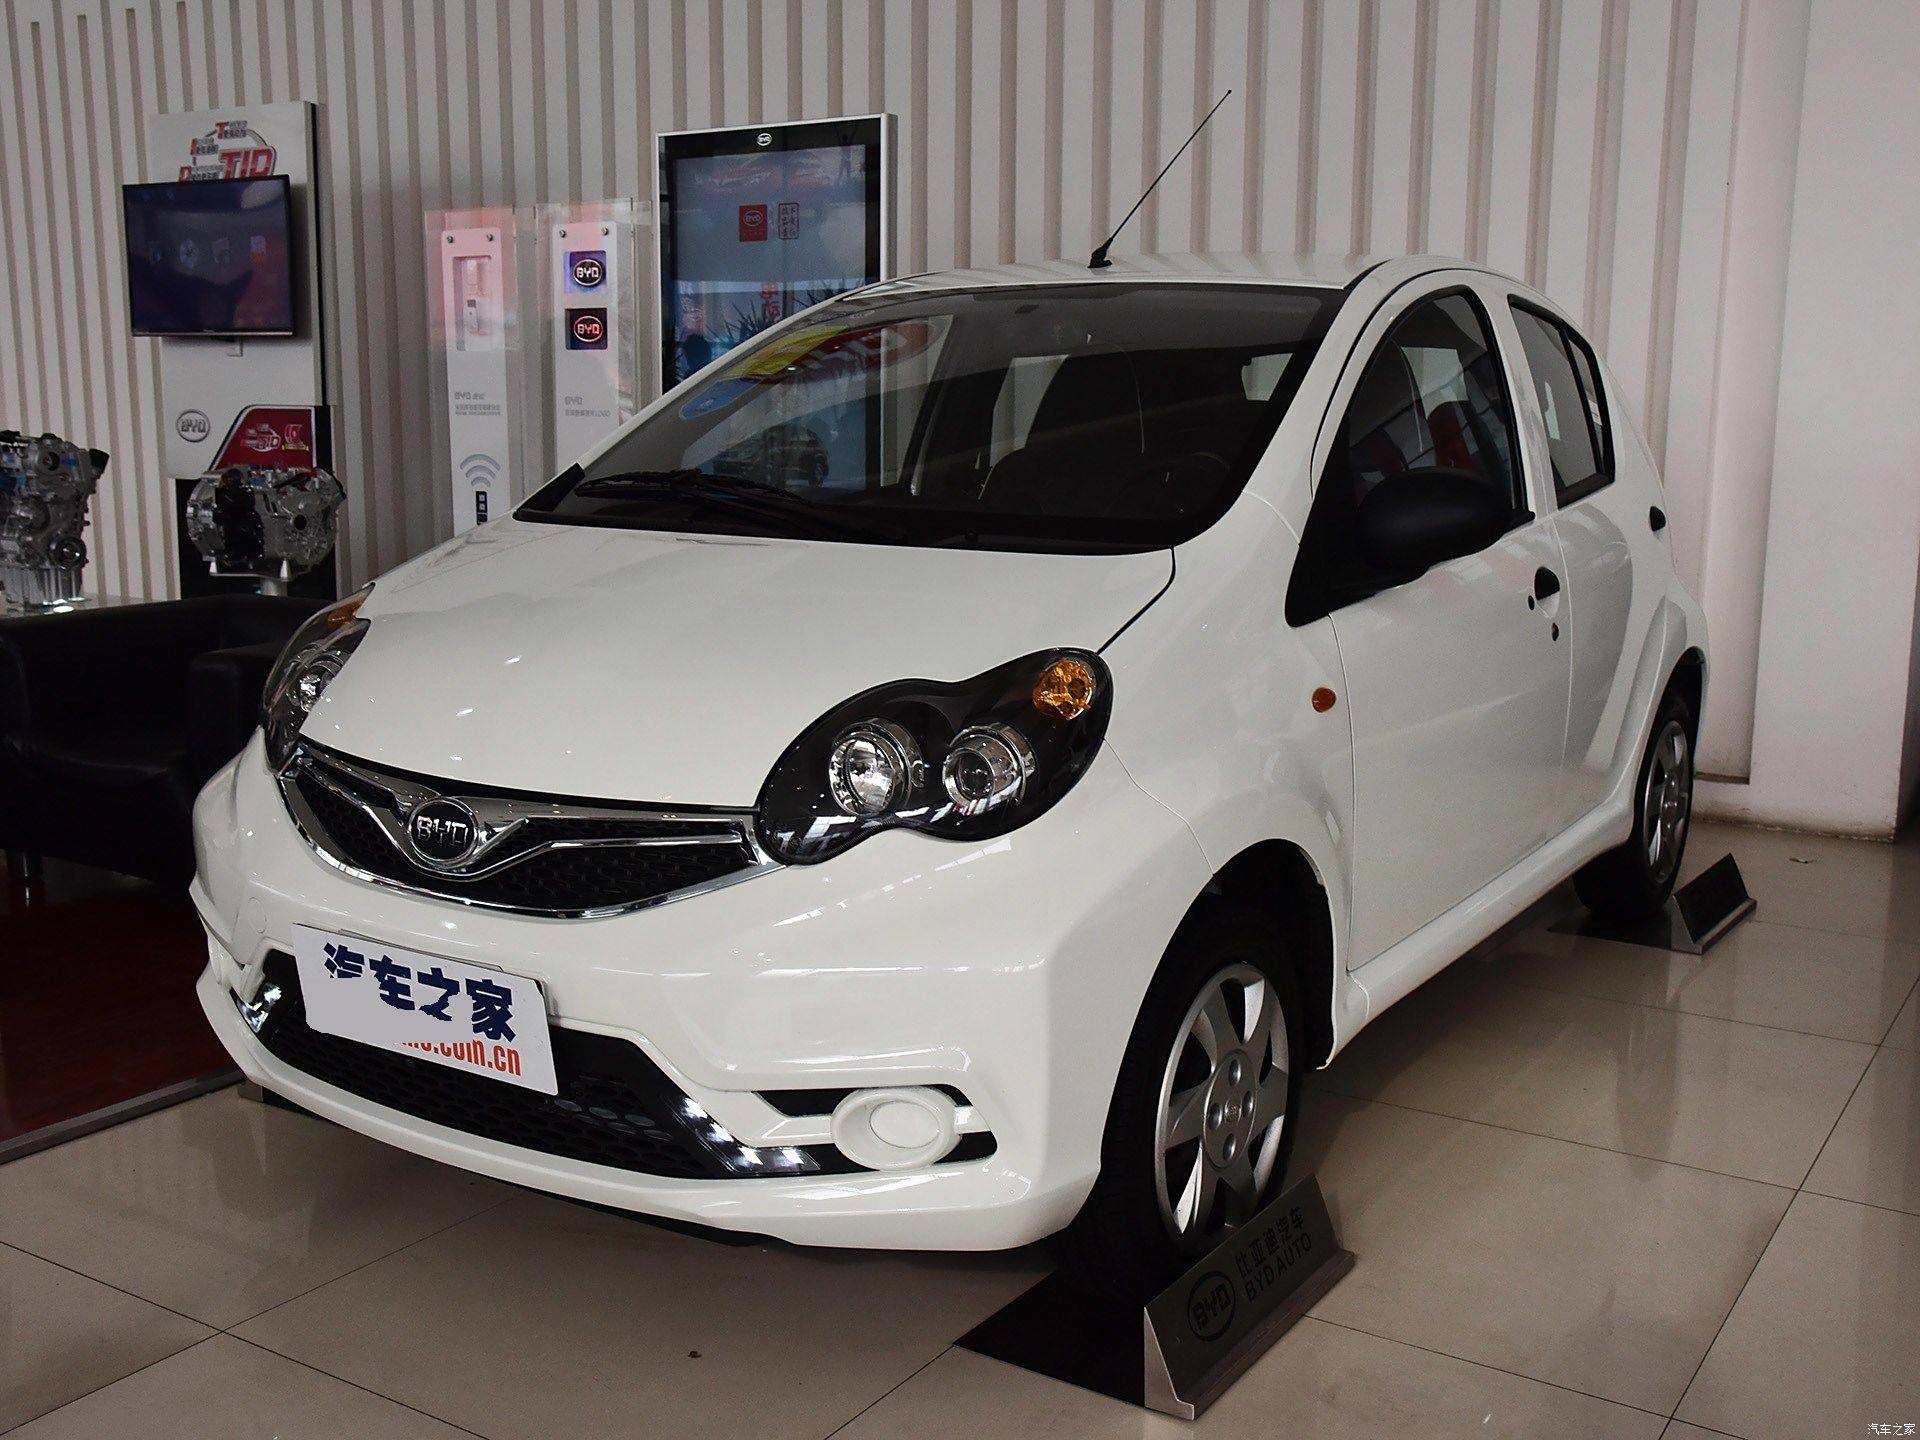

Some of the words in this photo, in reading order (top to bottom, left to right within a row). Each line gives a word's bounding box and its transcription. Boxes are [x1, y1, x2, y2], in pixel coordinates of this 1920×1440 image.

[576, 267, 599, 278] BYD
[577, 323, 600, 334] BYD
[1236, 1207, 1304, 1278] 比亚迪汽车
[1245, 1265, 1275, 1301] BYD
[1276, 1233, 1312, 1276] AUTO
[1192, 1283, 1231, 1331] BYD
